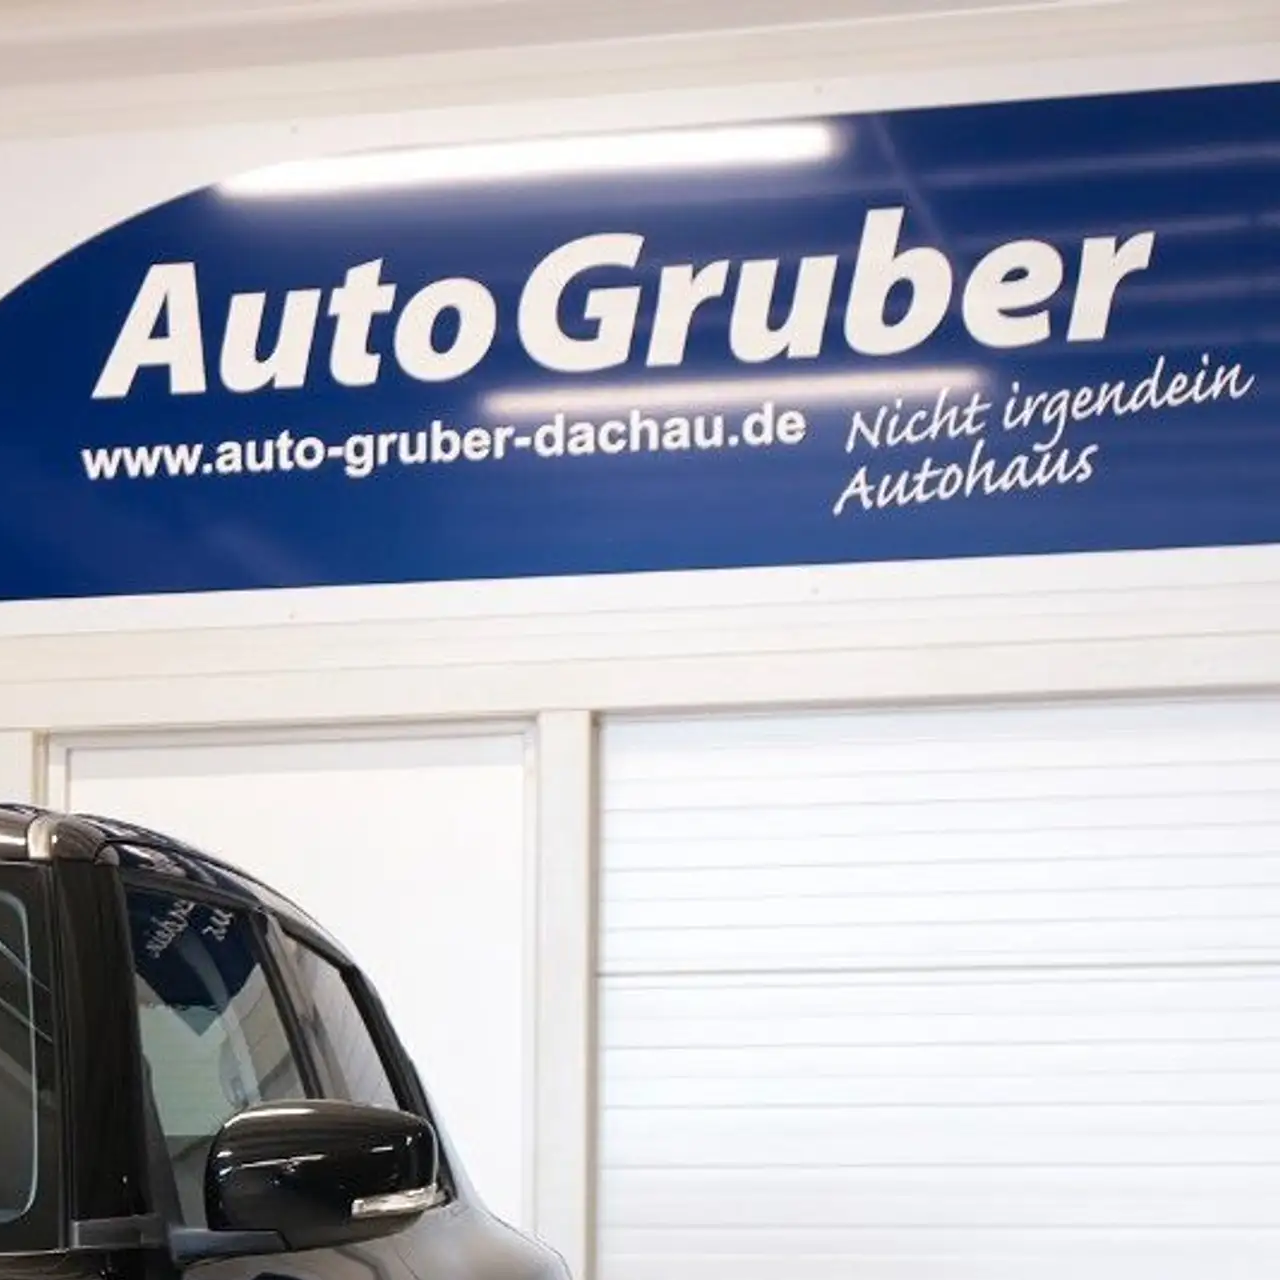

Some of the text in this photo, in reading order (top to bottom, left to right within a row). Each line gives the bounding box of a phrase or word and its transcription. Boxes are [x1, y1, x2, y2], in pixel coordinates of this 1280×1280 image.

[81, 402, 807, 480] www.auto-gruber-dachau.de
[845, 354, 1255, 453] Nicht irgendein
[833, 438, 1099, 517] Autohaus
